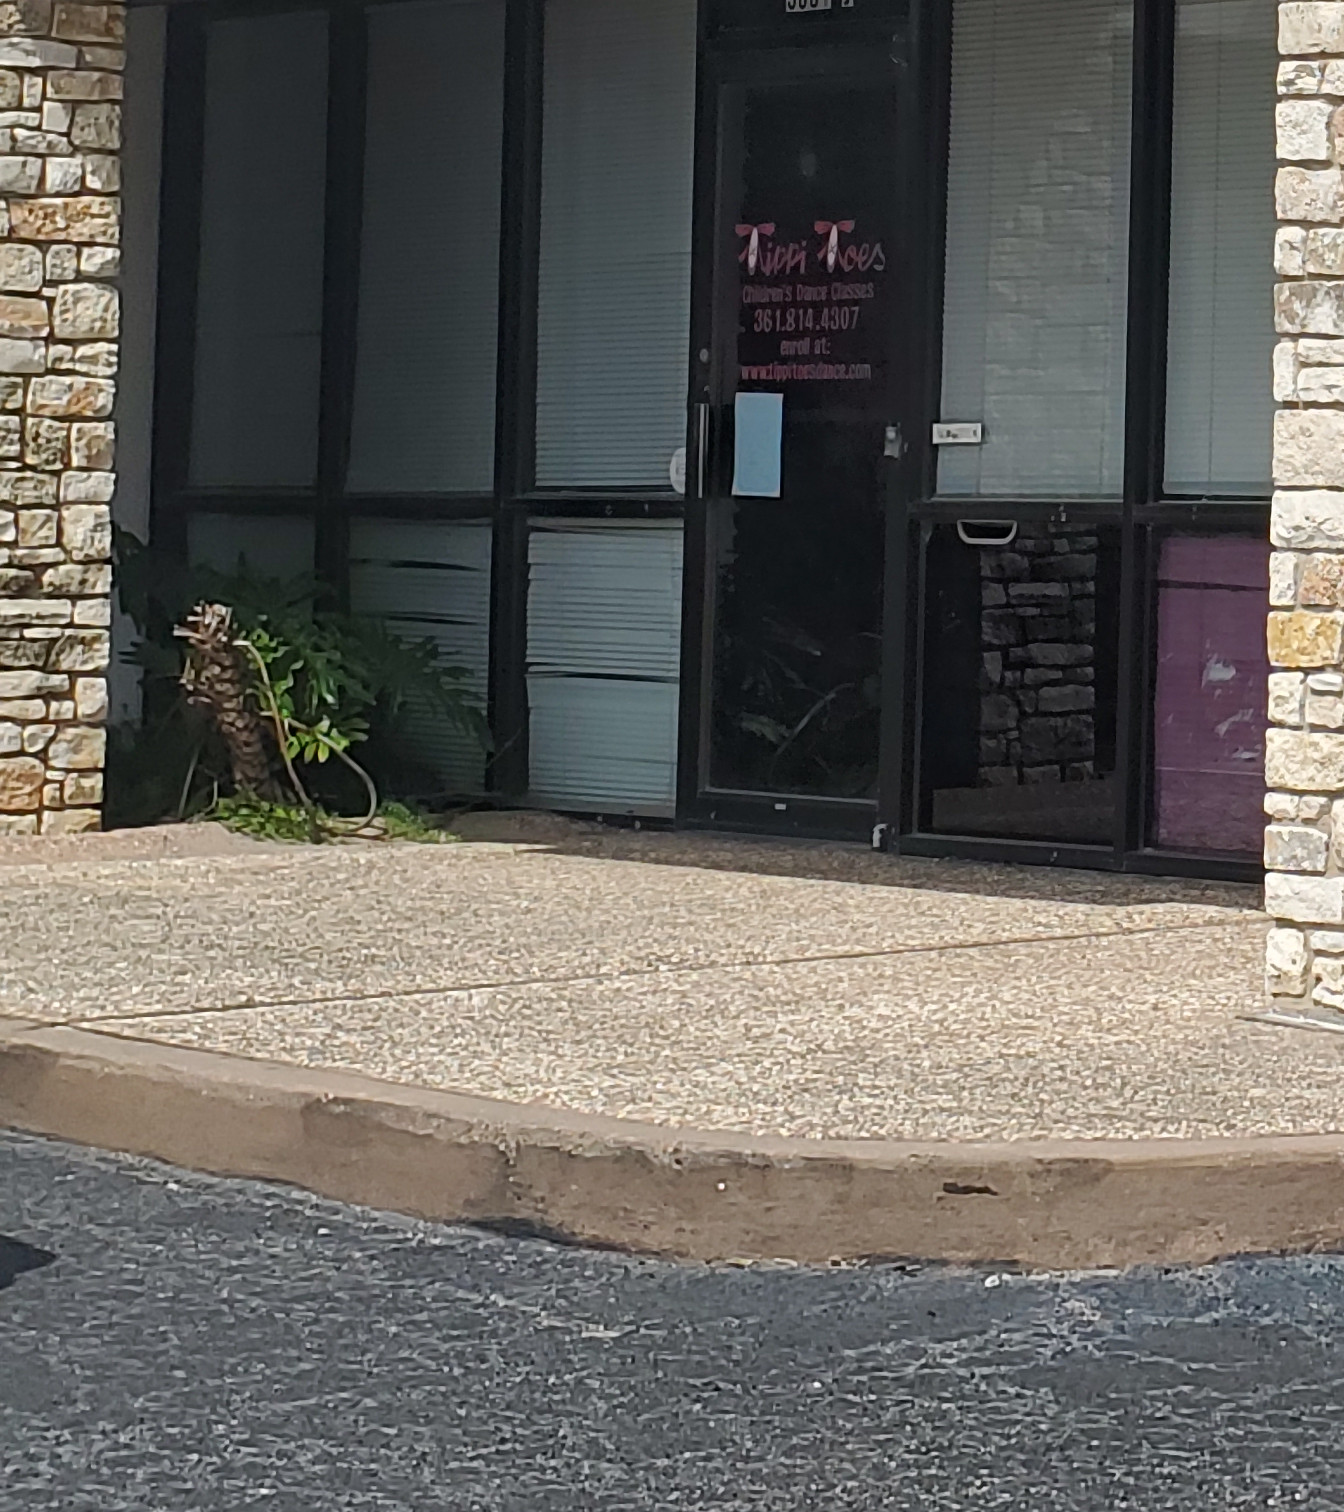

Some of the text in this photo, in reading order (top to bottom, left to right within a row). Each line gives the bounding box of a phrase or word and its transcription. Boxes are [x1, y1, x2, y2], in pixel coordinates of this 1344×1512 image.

[735, 220, 886, 276] Tippi Toes
[754, 306, 860, 333] 361.814.4307
[780, 338, 810, 355] enroll
